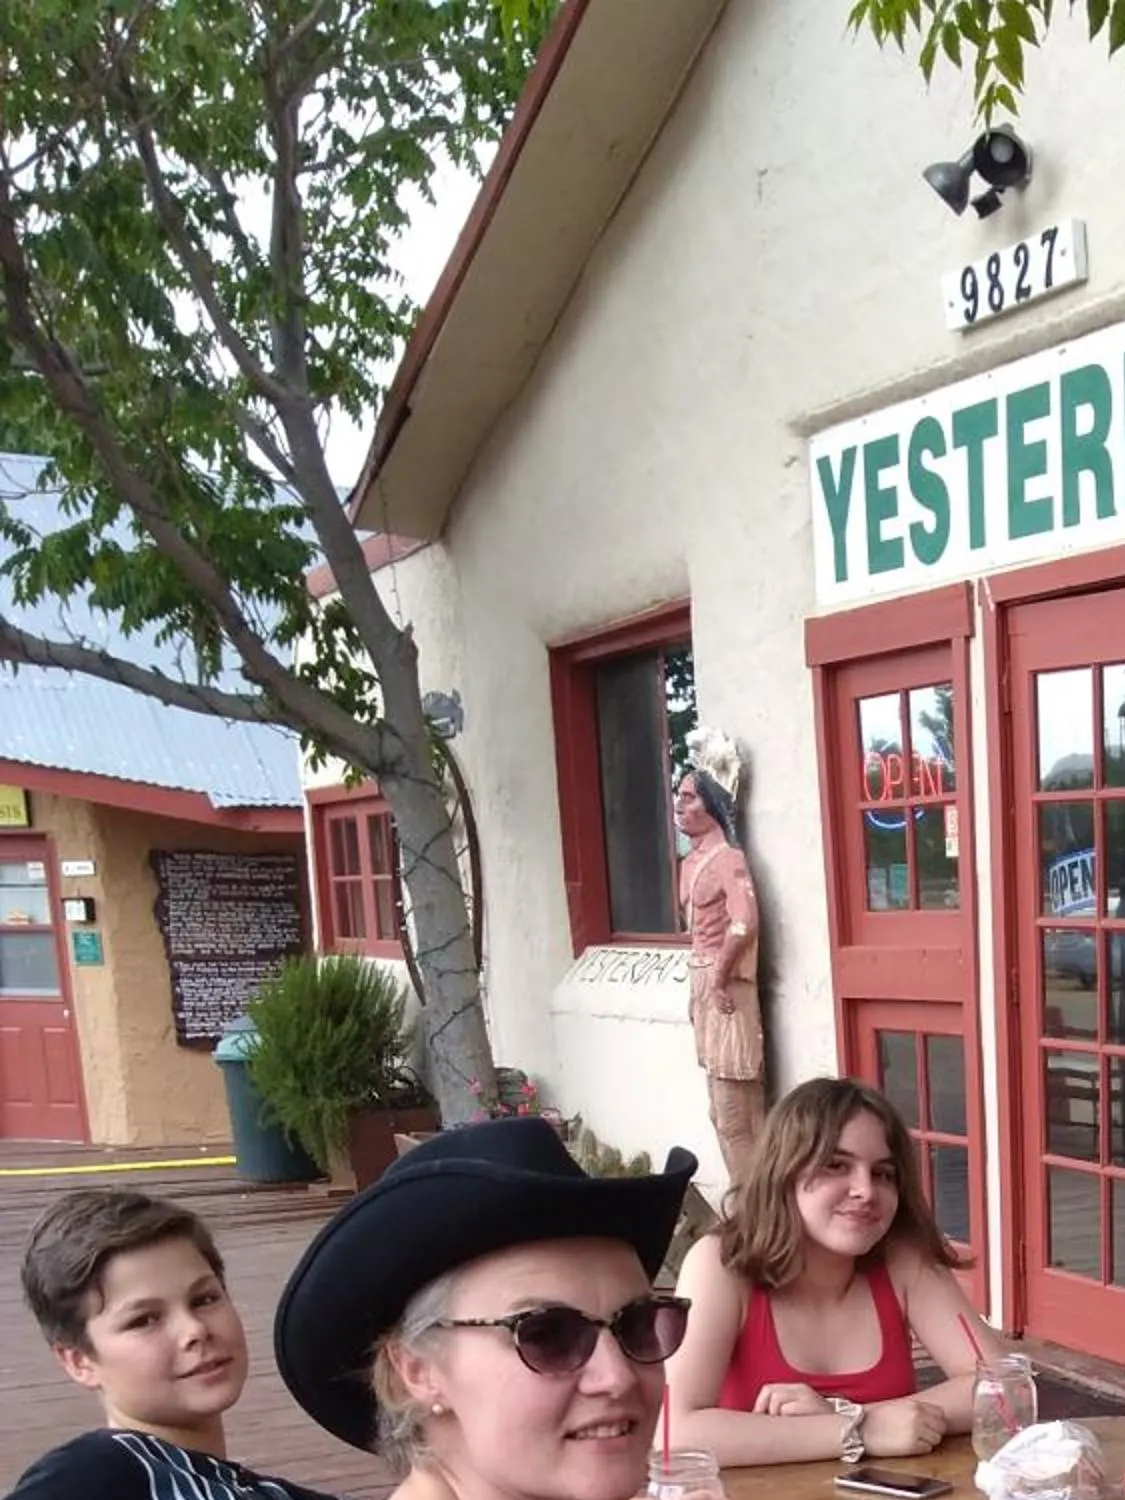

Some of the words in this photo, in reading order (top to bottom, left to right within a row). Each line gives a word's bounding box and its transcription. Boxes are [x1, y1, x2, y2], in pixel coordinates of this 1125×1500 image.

[960, 226, 1058, 323] 9827
[863, 752, 943, 801] OPN
[1051, 857, 1096, 911] OPEN
